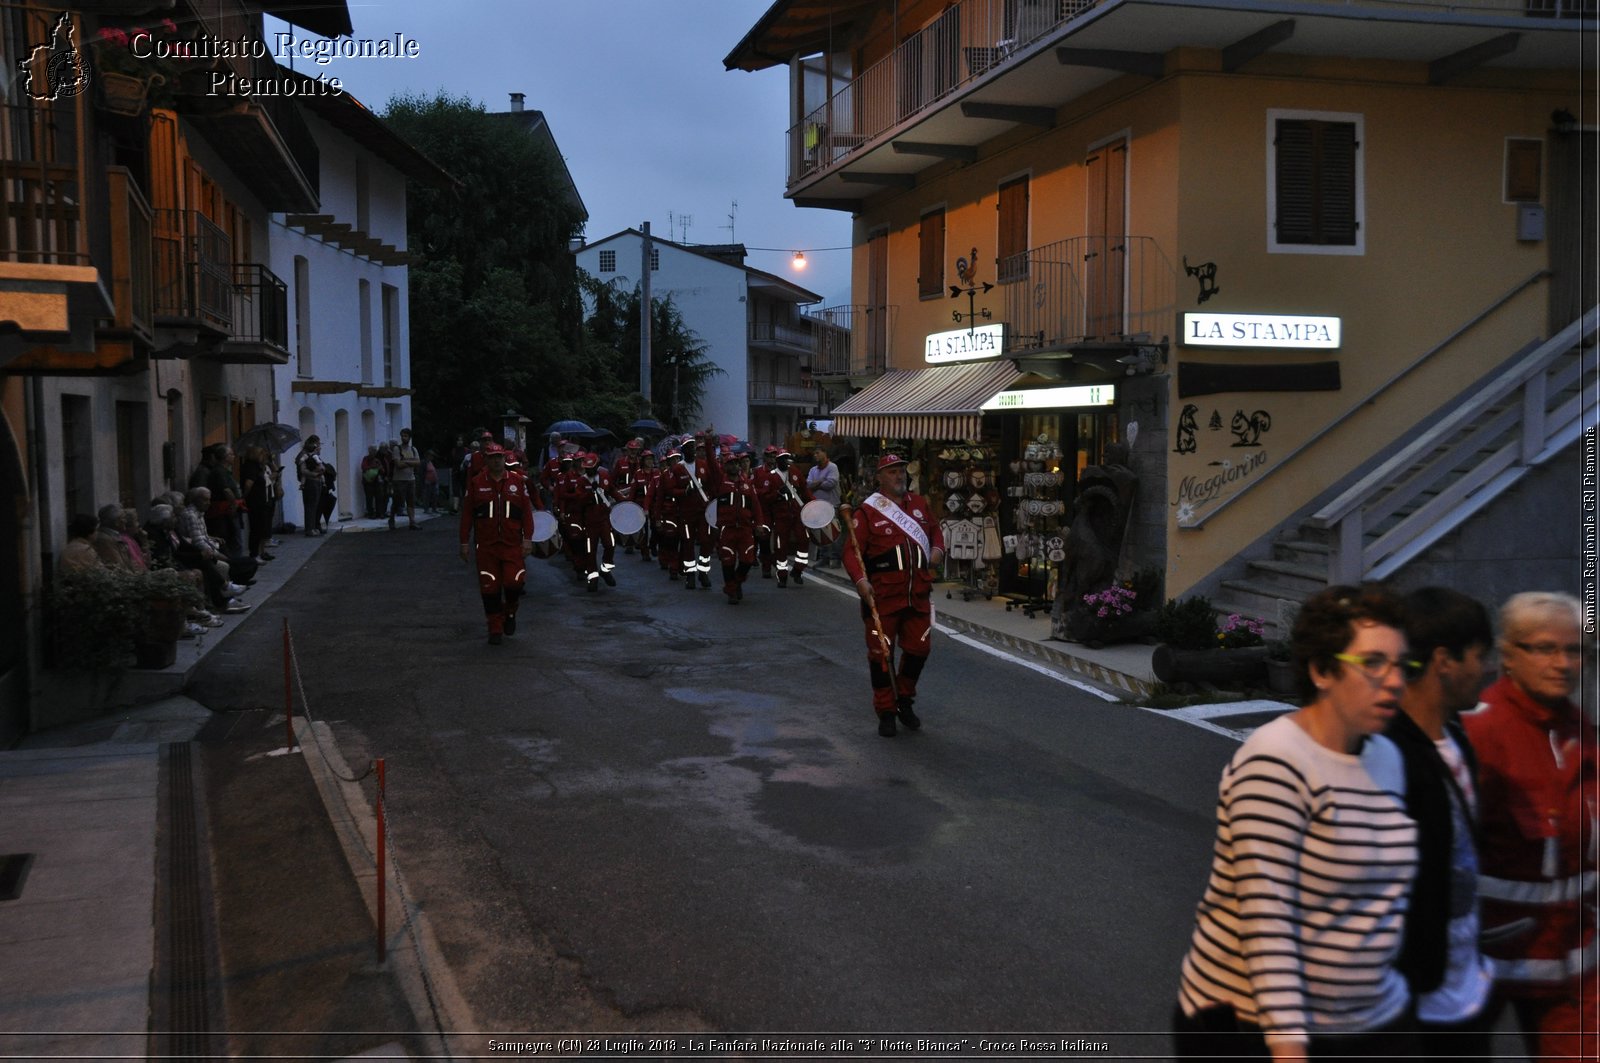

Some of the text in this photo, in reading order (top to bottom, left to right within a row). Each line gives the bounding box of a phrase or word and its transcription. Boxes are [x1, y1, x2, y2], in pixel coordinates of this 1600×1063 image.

[1191, 320, 1332, 342] LA STAMPA
[928, 331, 995, 357] LA STAMPA
[1172, 451, 1268, 505] Maggiorino
[892, 511, 916, 531] CROCE
